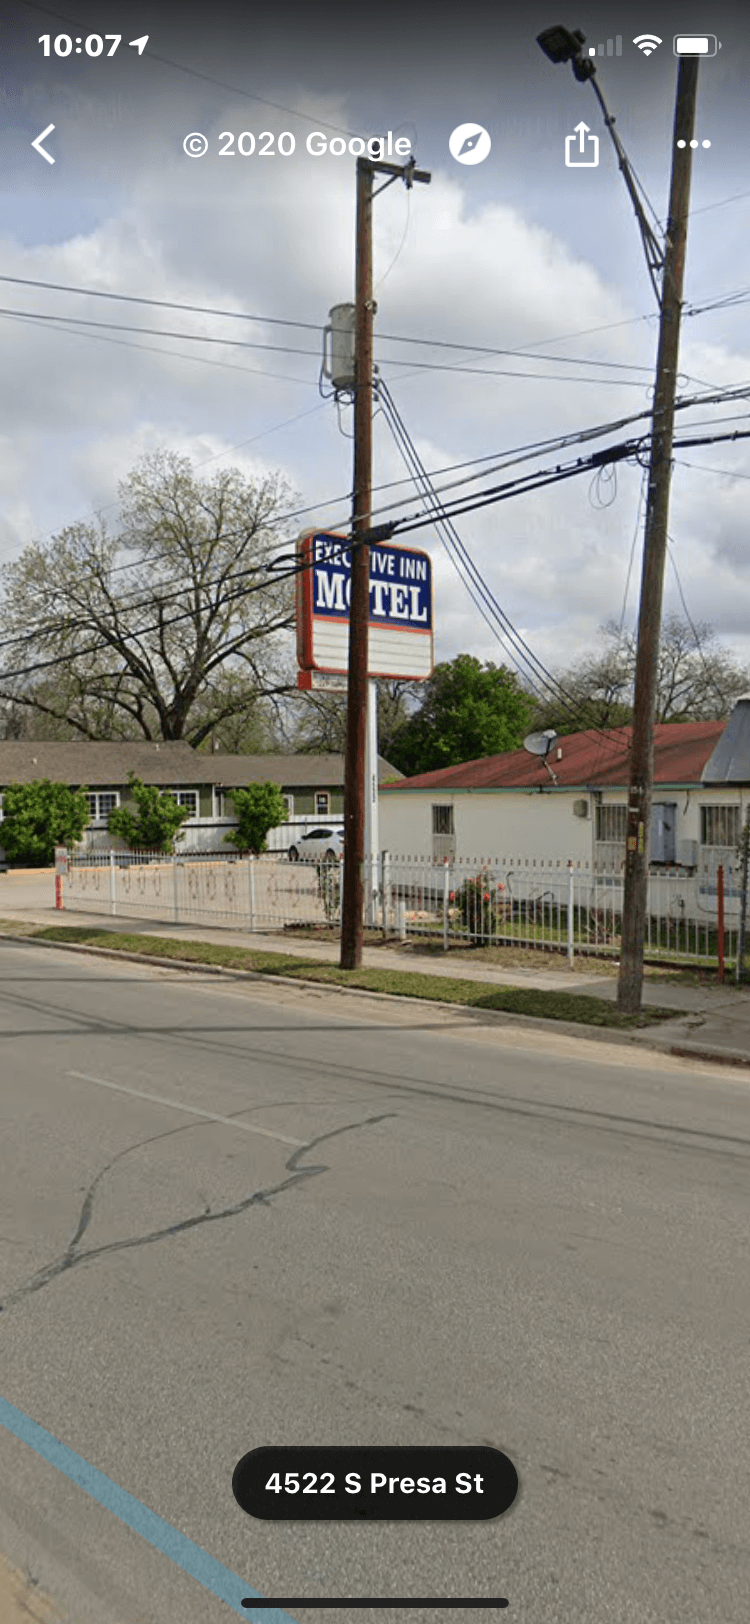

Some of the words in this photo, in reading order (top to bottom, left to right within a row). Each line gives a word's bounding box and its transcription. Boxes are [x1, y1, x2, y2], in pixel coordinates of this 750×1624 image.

[315, 540, 395, 575] EXECIVE
[400, 557, 427, 581] INN
[315, 570, 427, 622] MTEL
